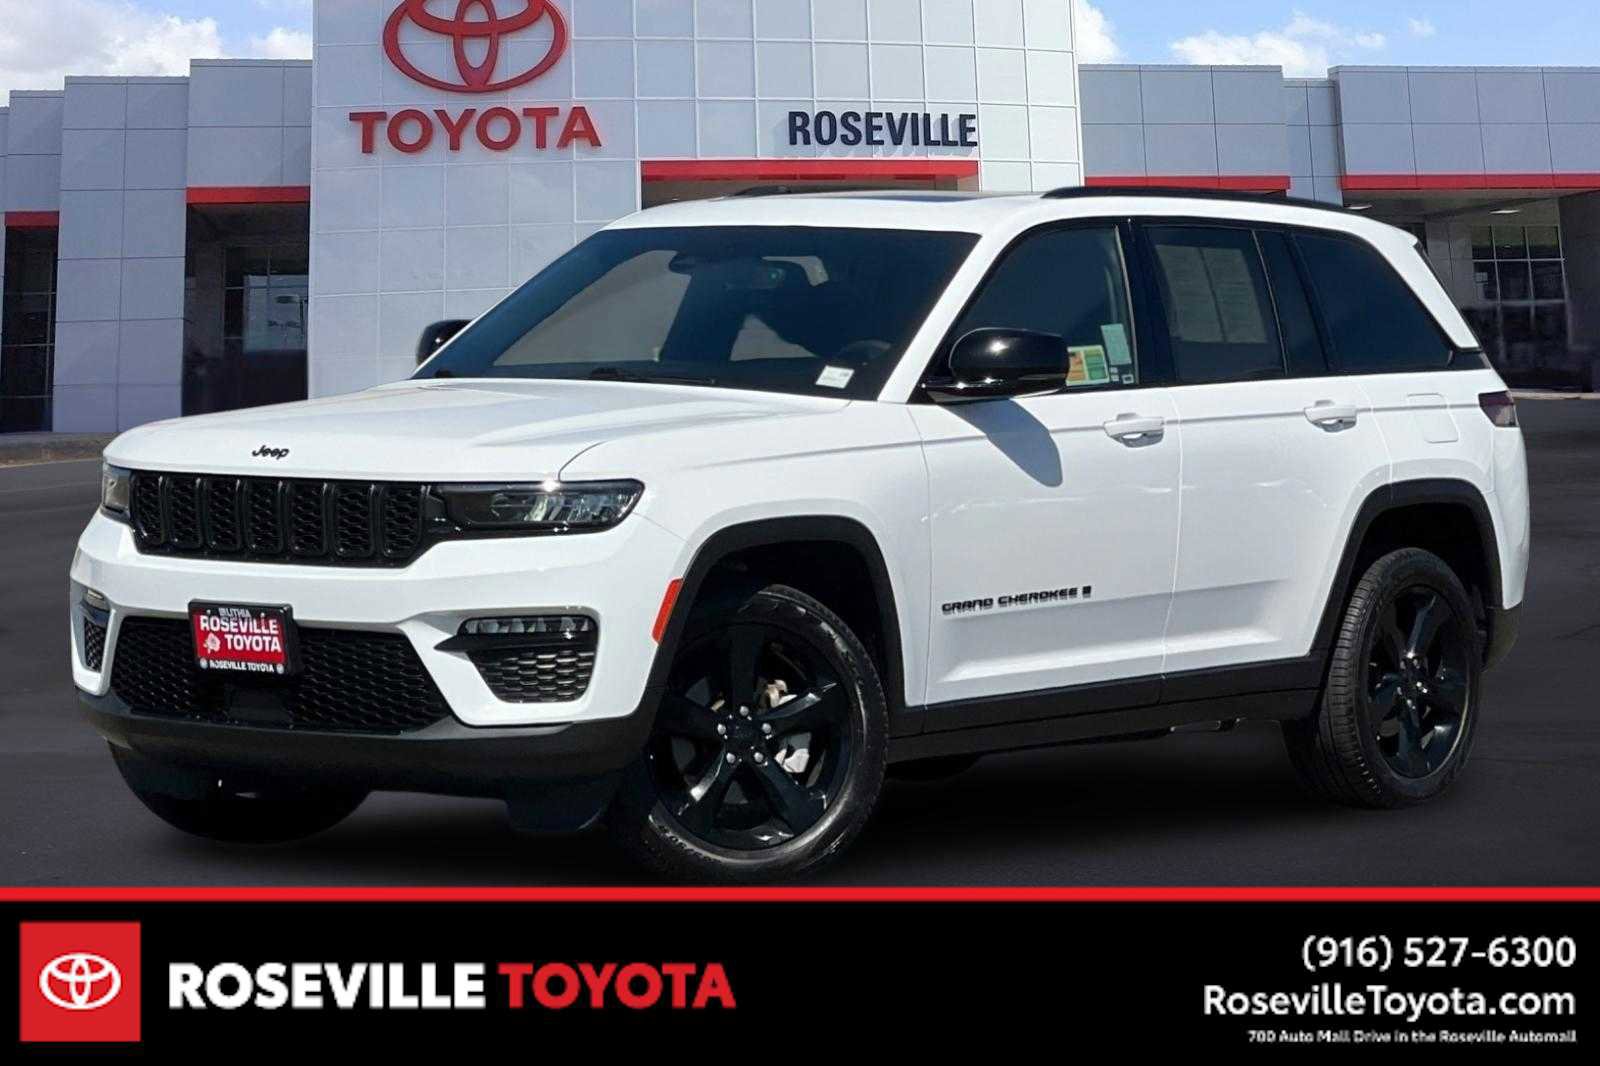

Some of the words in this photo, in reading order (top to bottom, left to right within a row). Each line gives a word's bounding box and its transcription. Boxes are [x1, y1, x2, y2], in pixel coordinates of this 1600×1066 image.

[349, 106, 602, 153] TOYOTA
[788, 110, 978, 147] ROSEVILLE
[252, 444, 290, 461] Jeep
[941, 597, 994, 615] GRAND
[997, 587, 1078, 606] CHEROKEE
[225, 608, 251, 618] LITHIA
[200, 614, 279, 635] ROSEVILLE
[224, 634, 282, 652] TOYOTA
[209, 660, 247, 671] ROSEVILLE
[247, 662, 275, 672] TOYOTA
